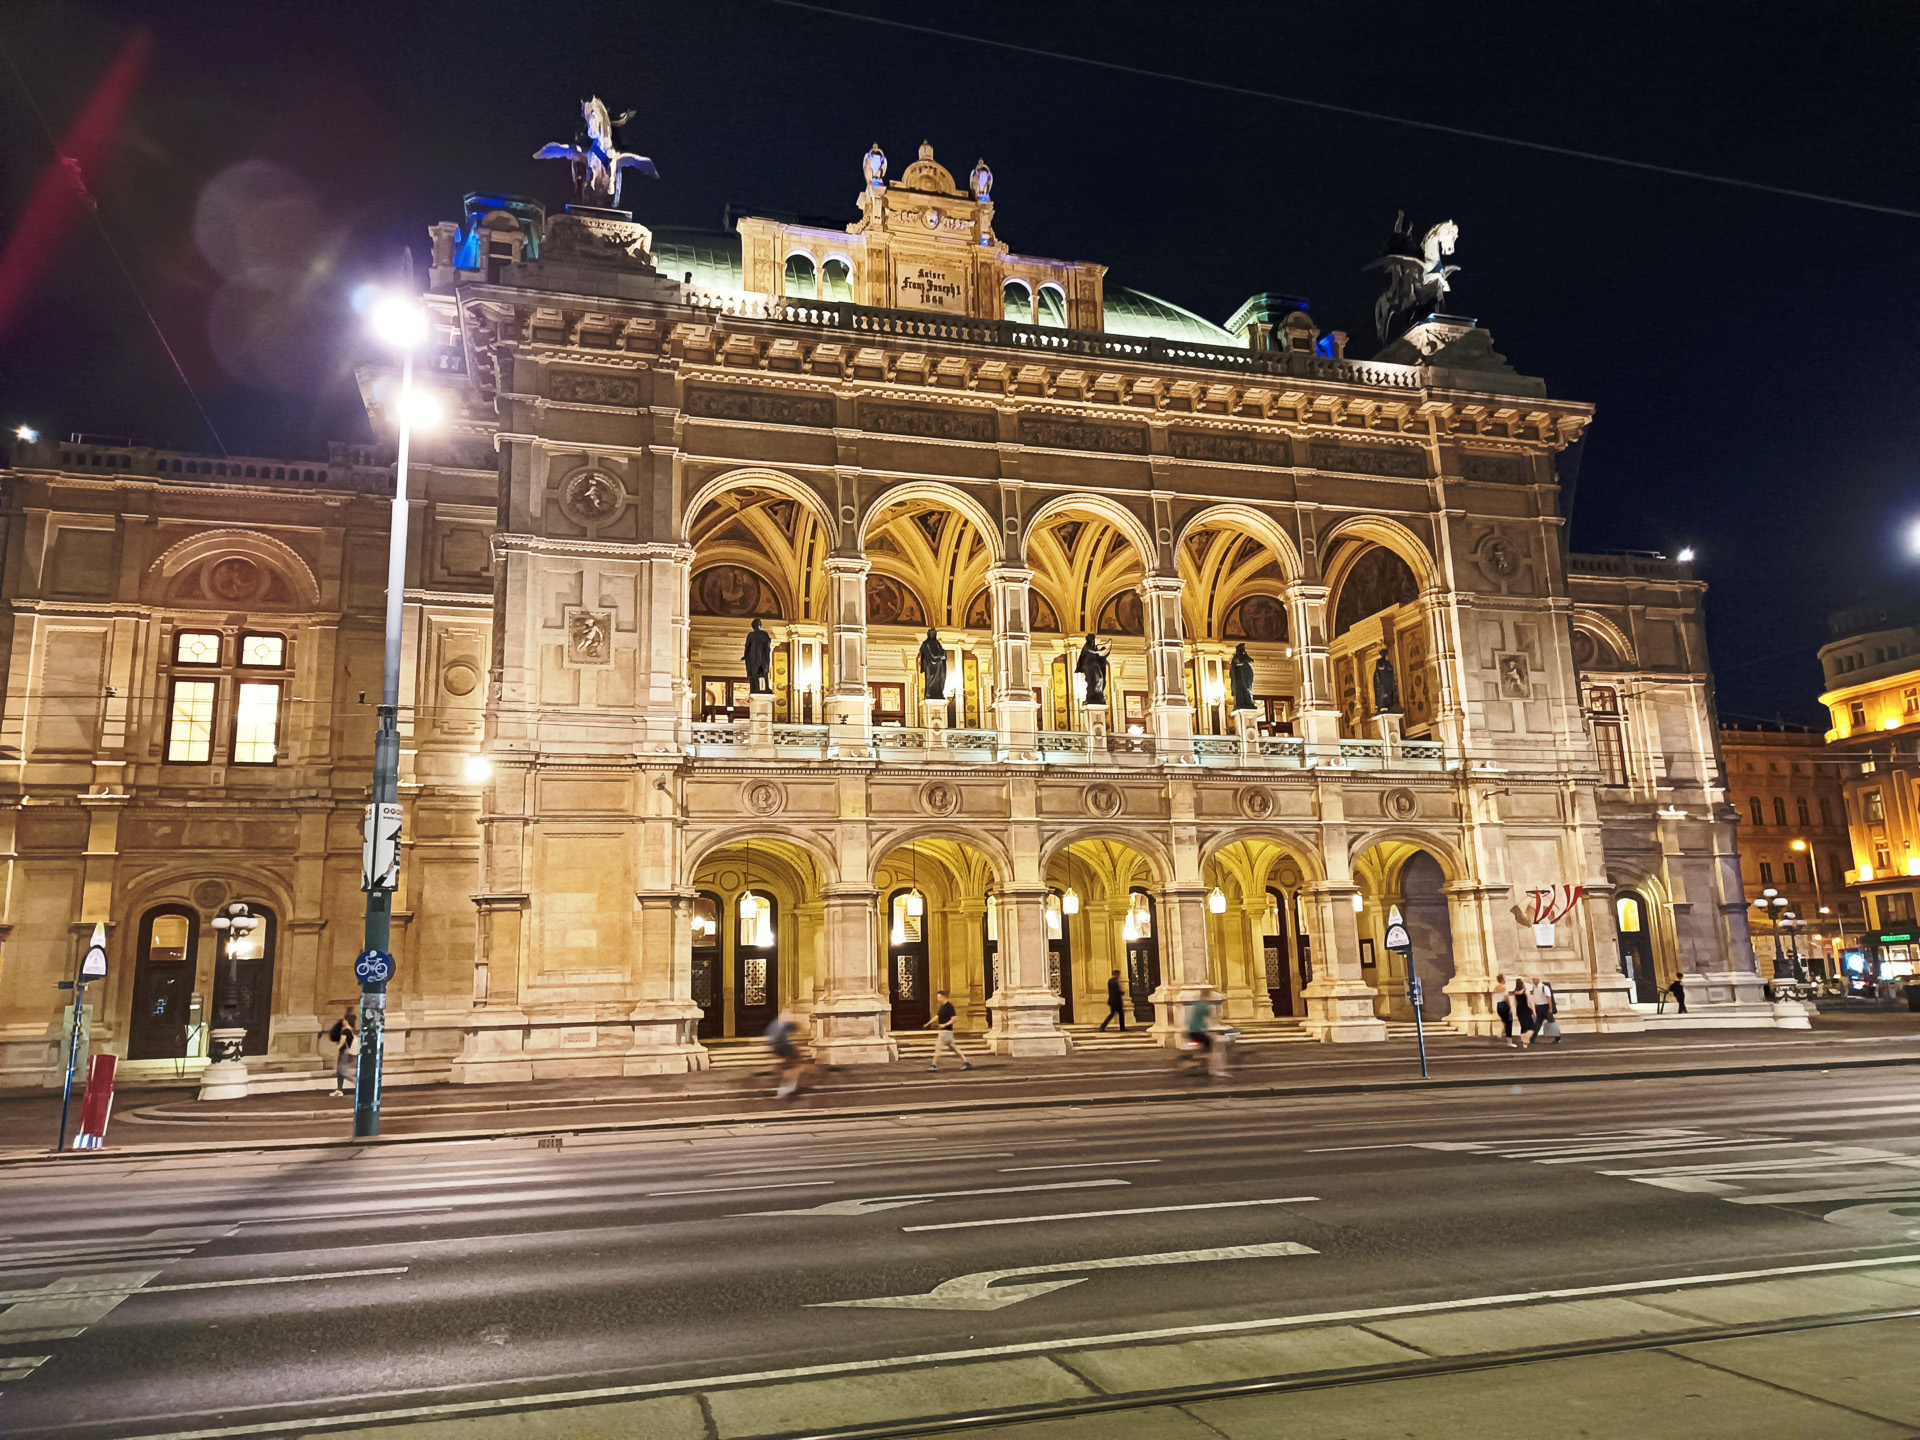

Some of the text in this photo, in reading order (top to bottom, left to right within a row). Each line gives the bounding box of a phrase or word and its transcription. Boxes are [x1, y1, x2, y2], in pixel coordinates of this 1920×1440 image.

[917, 268, 946, 280] Kaiser
[901, 276, 925, 295] Franz
[926, 279, 955, 298] Joseph
[920, 294, 944, 305] 1868
